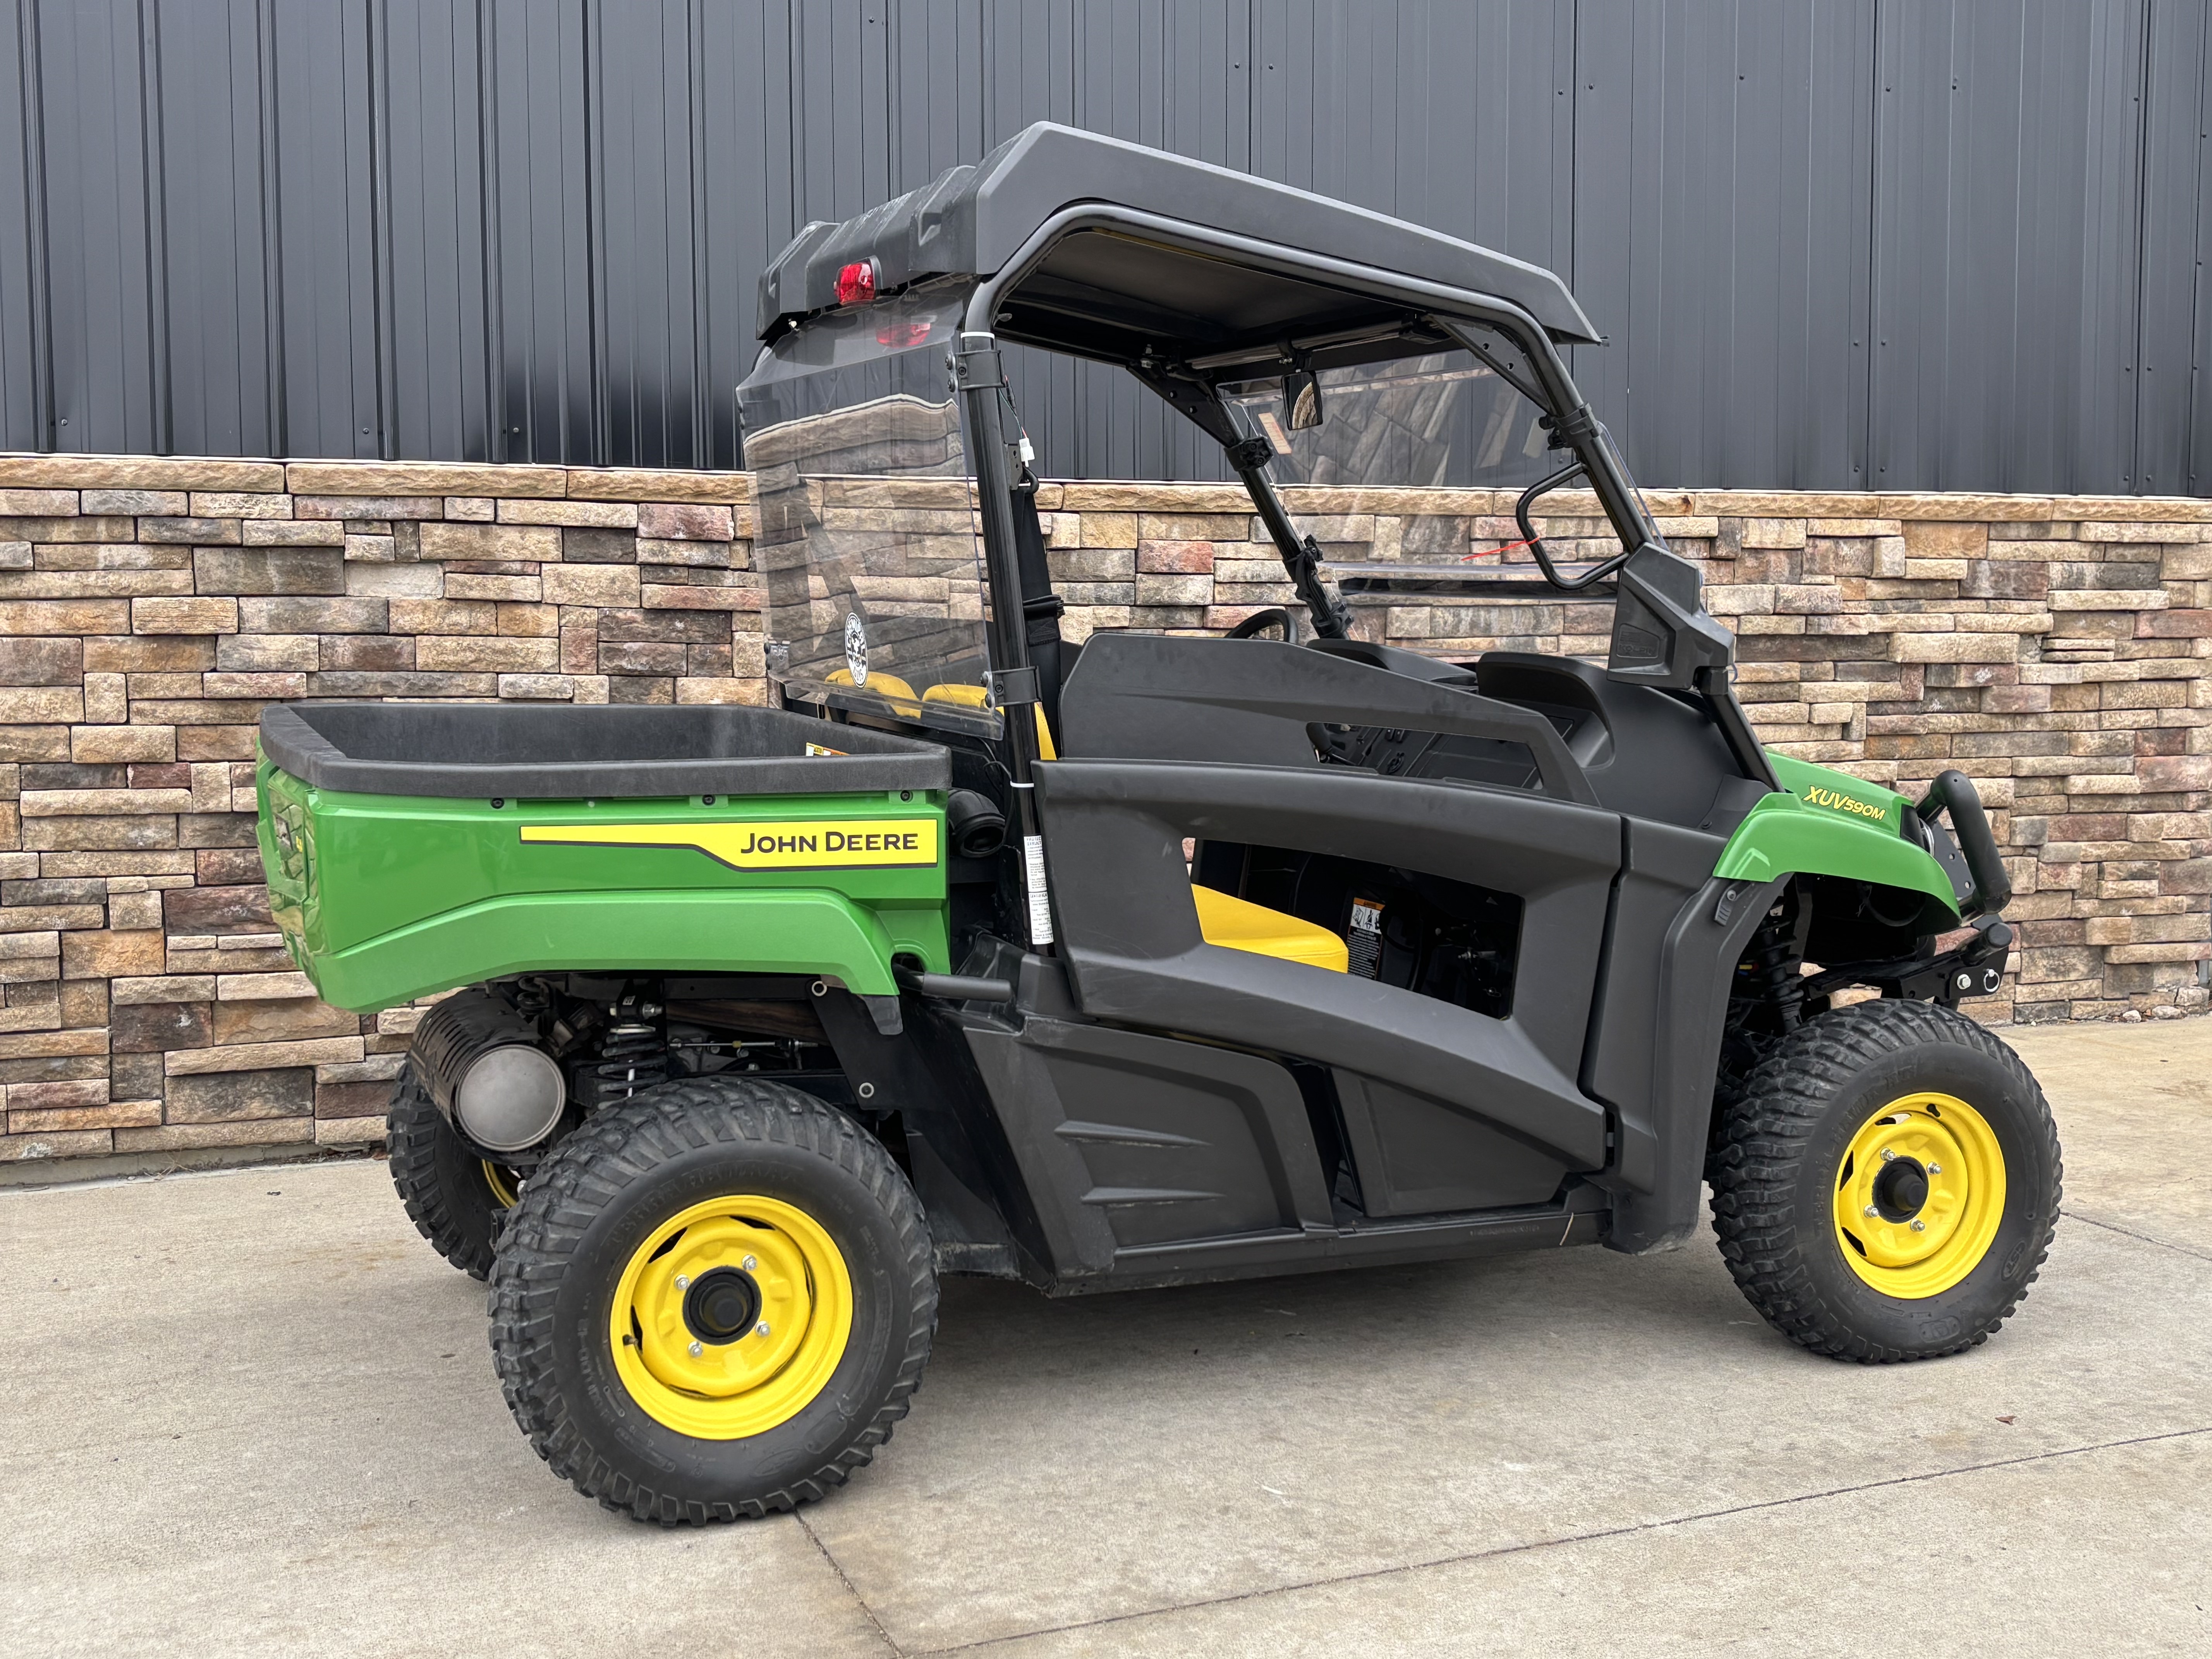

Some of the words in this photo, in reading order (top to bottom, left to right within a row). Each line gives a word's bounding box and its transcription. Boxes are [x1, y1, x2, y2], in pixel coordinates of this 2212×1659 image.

[1802, 785, 1886, 821] XUV590M
[740, 833, 816, 854] JOHN
[826, 831, 918, 852] DEERE
